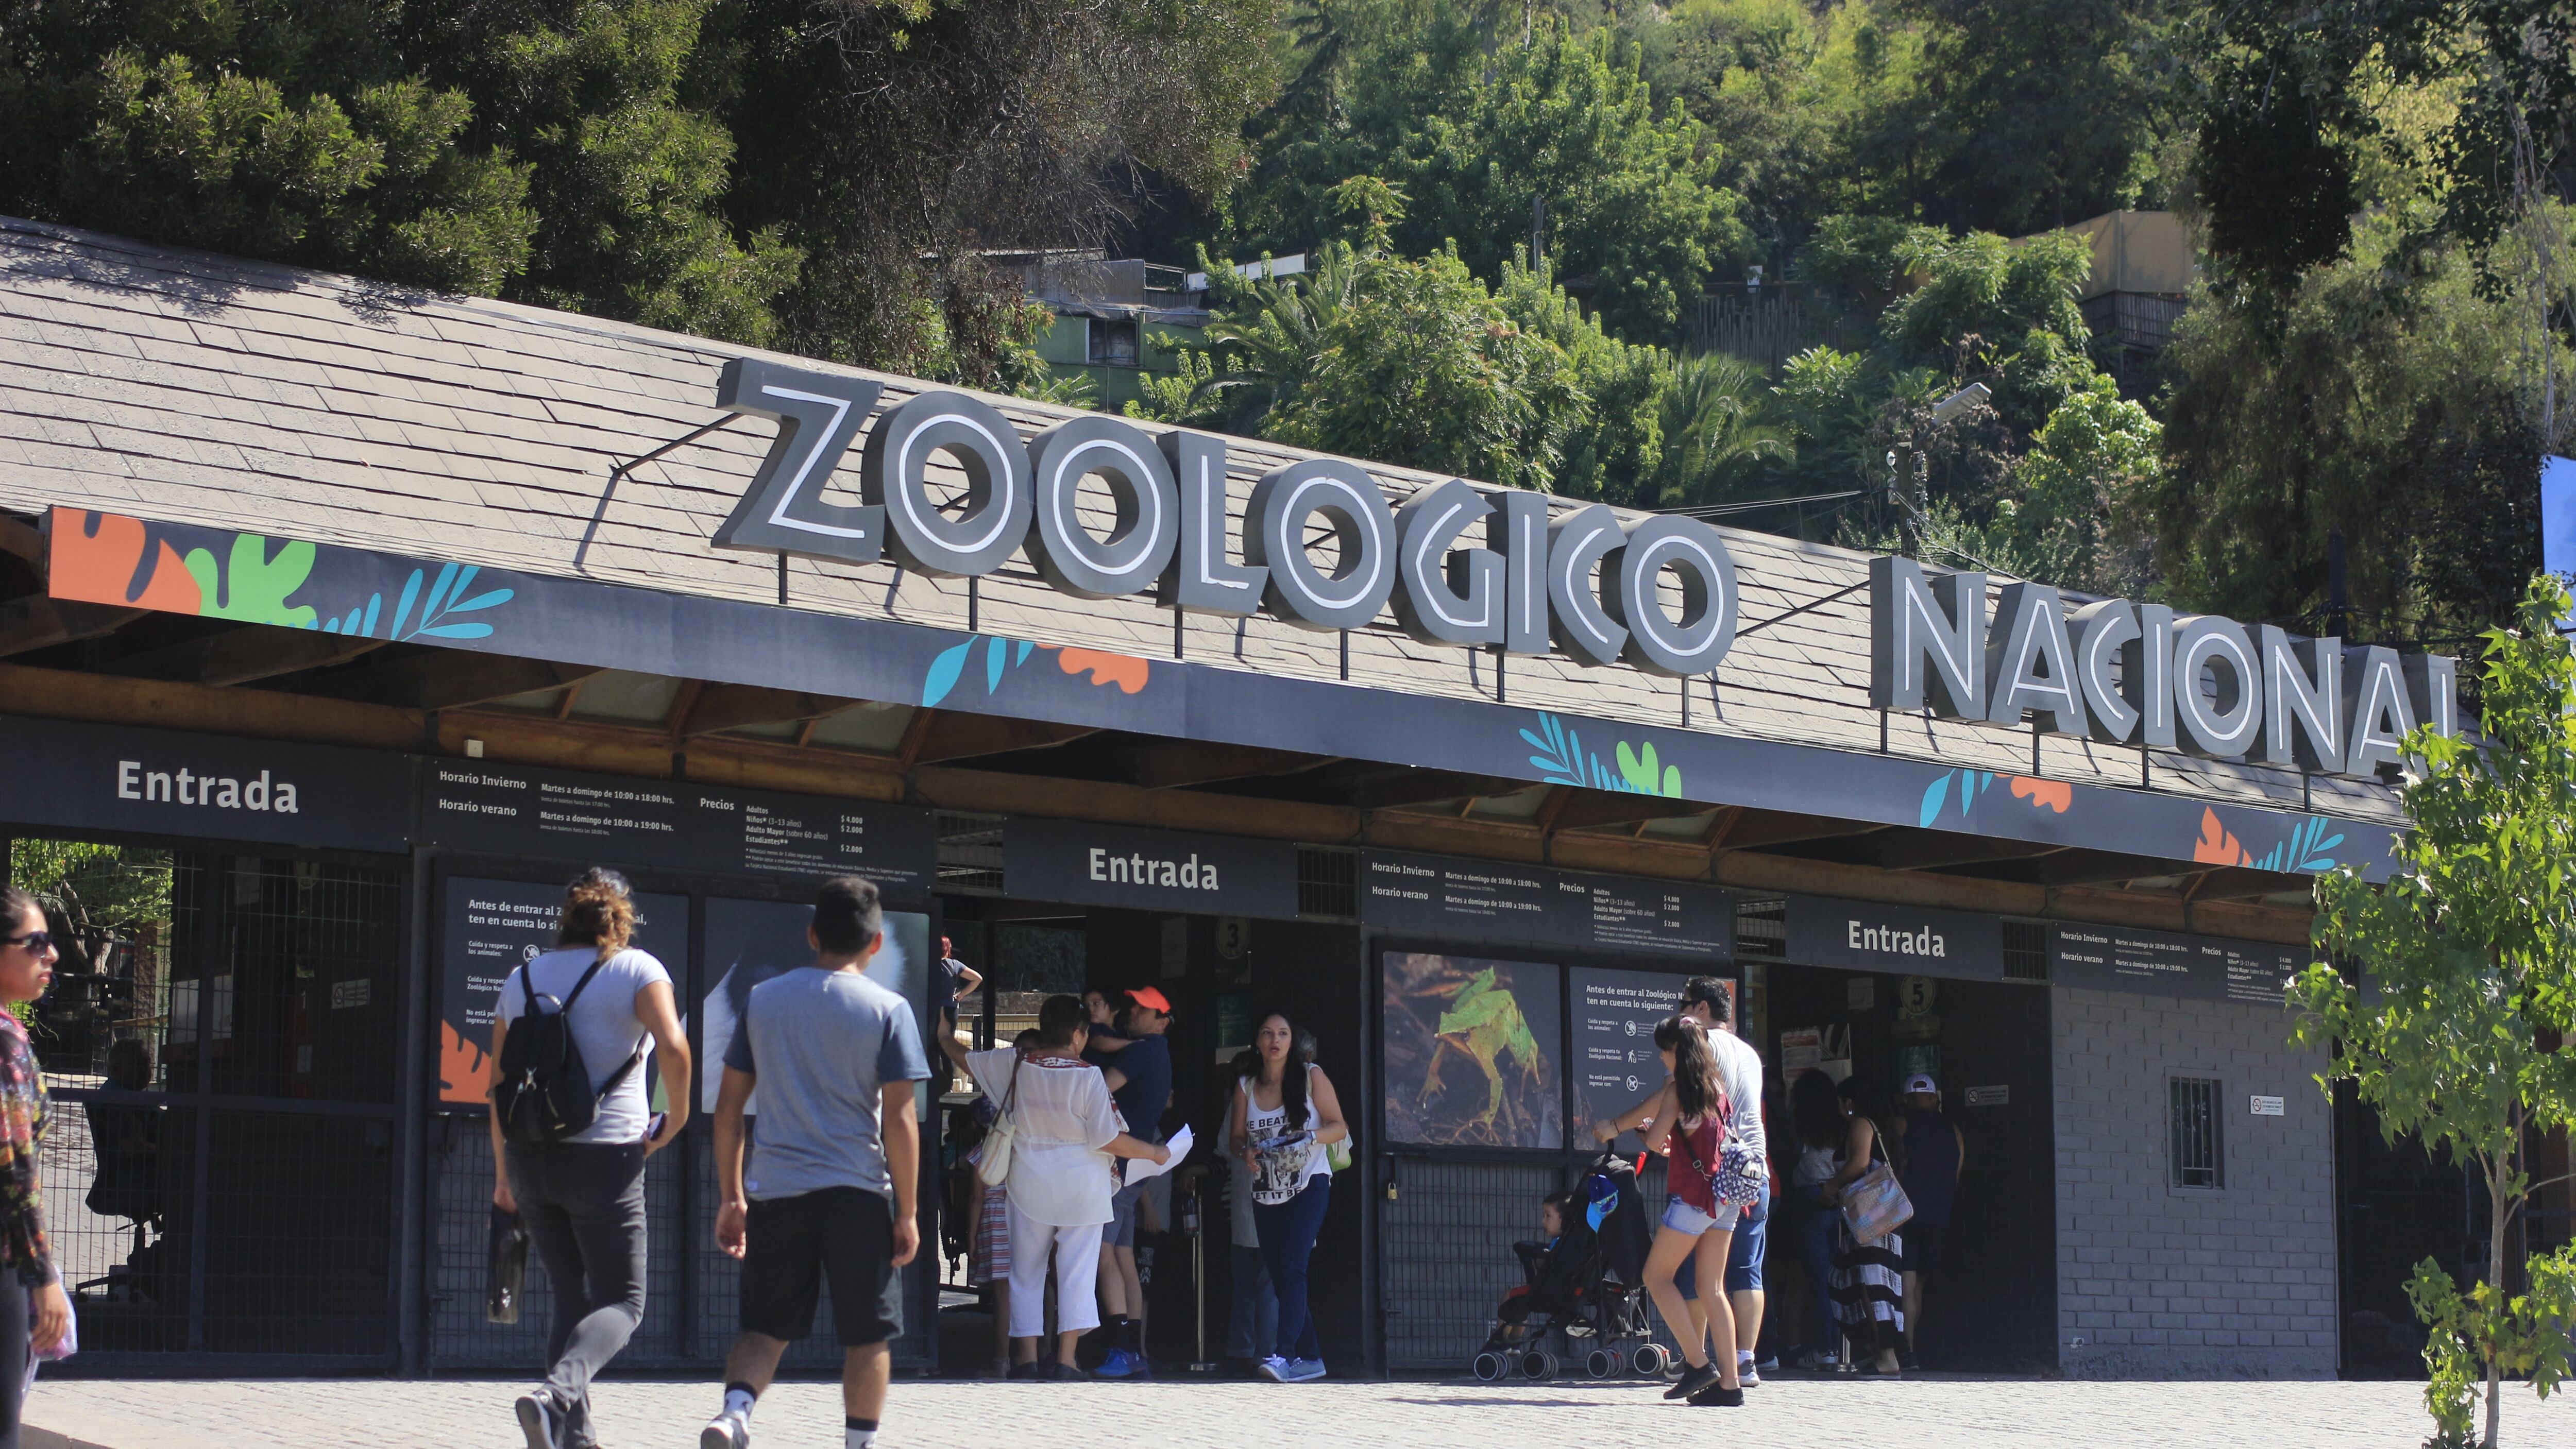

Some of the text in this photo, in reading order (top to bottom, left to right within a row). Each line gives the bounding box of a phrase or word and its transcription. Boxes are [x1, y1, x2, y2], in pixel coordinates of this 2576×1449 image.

[711, 357, 1738, 677] ZOOLOGICO
[440, 771, 526, 789] Horario Invierno
[118, 760, 298, 814] Entrada
[541, 783, 565, 793] Martes
[573, 787, 602, 798] domingo
[615, 791, 633, 799] 10:00
[641, 794, 660, 802] 18:00
[662, 795, 674, 804] hrs.
[439, 799, 516, 815] Horario verano
[701, 798, 734, 810] Precios
[746, 806, 768, 814] Adultos
[540, 811, 564, 821] Martes
[572, 814, 601, 826] domingo
[614, 819, 633, 827] 10:00
[641, 821, 659, 830] 19:00
[662, 823, 673, 831] hrs.
[746, 825, 765, 833] Adulto
[767, 827, 784, 837] Mayor
[1090, 848, 1219, 891] Entrada
[1372, 862, 1434, 877] Horario Invierno
[1445, 872, 1462, 880] Martes
[1468, 874, 1489, 883] domingo
[1372, 886, 1428, 899] Horario verano
[1560, 882, 1584, 893] Precios
[469, 899, 496, 910] Antes
[499, 901, 511, 911] de
[513, 905, 543, 914] entrar
[545, 906, 554, 915] al
[1468, 898, 1489, 907] domingo
[469, 914, 484, 924] ten
[502, 918, 534, 928] cuenta
[537, 919, 546, 929] lo
[1227, 923, 1238, 948] 3
[1848, 920, 1945, 958] Entrada
[2061, 931, 2107, 943] Horario Invierno
[2132, 941, 2148, 949] domingo
[2202, 947, 2221, 955] Precios
[2061, 952, 2082, 961] Horario
[467, 983, 493, 992] Zoológico
[1586, 985, 1605, 994] Antes
[1606, 986, 1615, 994] de
[1646, 990, 1676, 1000] Zoológico
[1913, 983, 1924, 1006] 5
[1641, 1001, 1673, 1011] siguiente:
[466, 1017, 488, 1025] ingresar
[1287, 1187, 1301, 1197] BE
